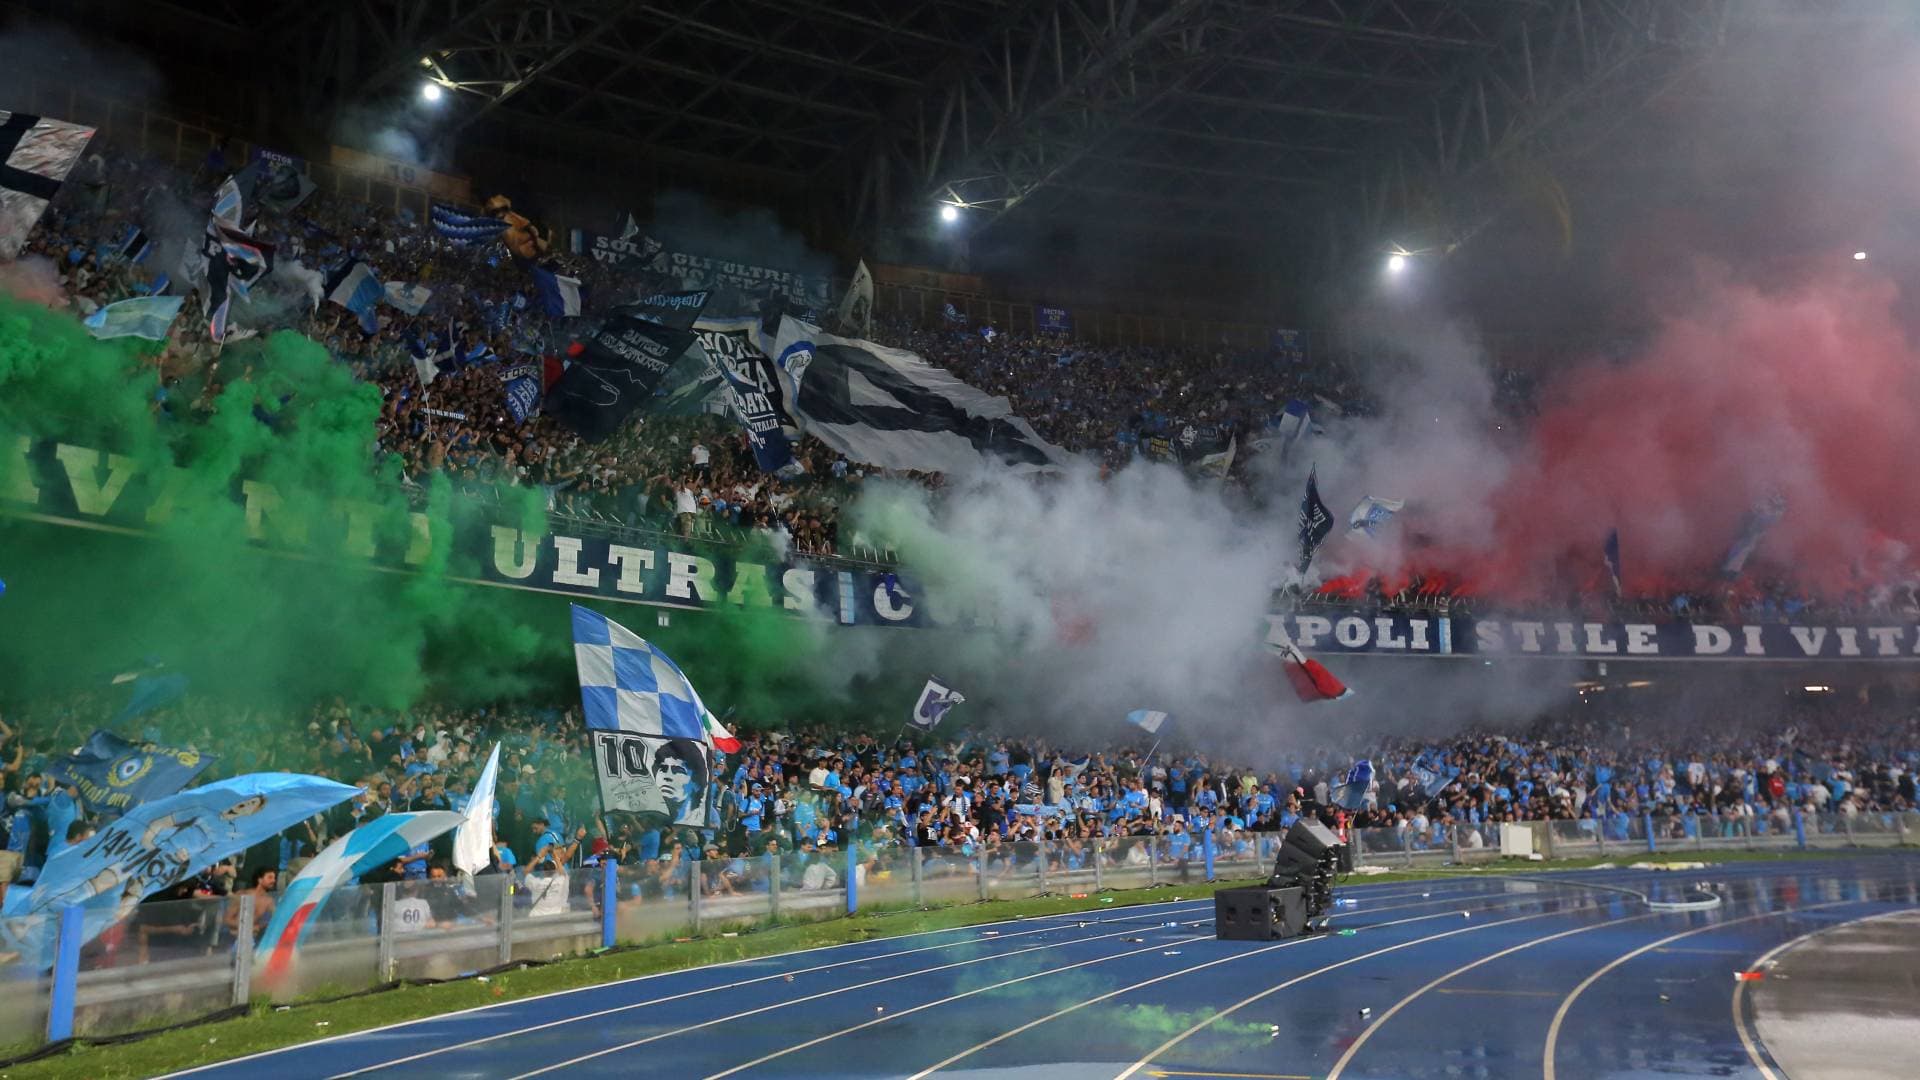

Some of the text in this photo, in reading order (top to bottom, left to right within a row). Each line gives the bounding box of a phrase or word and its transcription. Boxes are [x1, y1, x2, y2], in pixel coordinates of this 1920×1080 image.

[490, 524, 816, 611] ULTRAS
[1264, 614, 1431, 650] APOLI
[1475, 620, 1660, 655] STILE
[1691, 624, 1767, 656] DI
[599, 735, 650, 778] 10
[403, 909, 420, 923] 60
